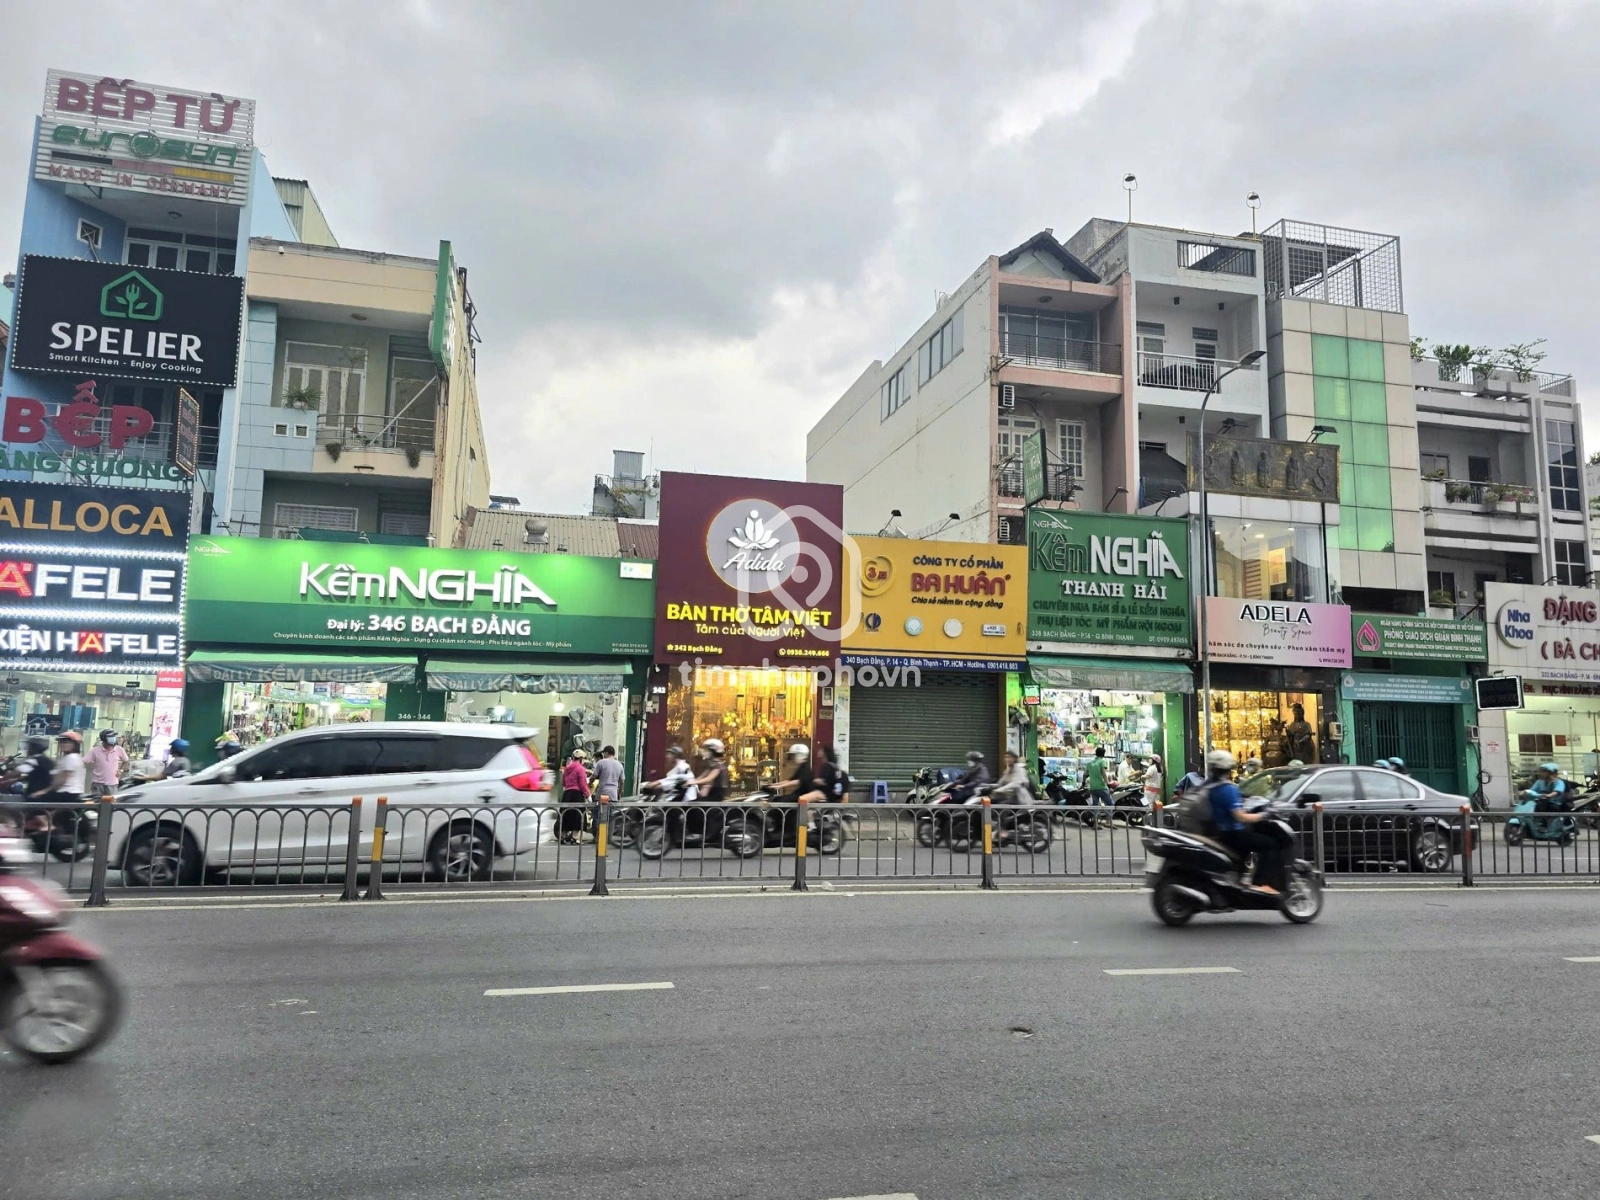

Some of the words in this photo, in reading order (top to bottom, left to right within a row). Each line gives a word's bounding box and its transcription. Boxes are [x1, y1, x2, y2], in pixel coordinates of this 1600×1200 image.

[56, 77, 156, 121] BẾP
[166, 92, 241, 134] TỪ
[49, 163, 102, 183] MADE
[116, 172, 134, 187] IN
[146, 177, 233, 200] GERMANY
[50, 322, 203, 362] SPELIER
[49, 353, 78, 363] Smart
[81, 355, 119, 366] Kitchen
[130, 360, 157, 371] Enjoy
[160, 363, 202, 374] Cooking
[722, 552, 786, 572] Adida
[913, 555, 942, 566] CÔNG
[944, 558, 958, 567] TY
[960, 555, 975, 568] CỔ
[976, 556, 1004, 569] PHẦN
[911, 572, 942, 593] BA
[944, 570, 1006, 596] HUÂN
[1062, 579, 1125, 598] THANH
[1133, 579, 1168, 600] HẢI
[911, 596, 928, 604] Chia
[985, 598, 1003, 609] đồng
[1544, 595, 1598, 626] ĐẶNG
[327, 619, 348, 632] Đại
[350, 619, 365, 632] lý:
[367, 615, 407, 631] 346
[411, 615, 467, 637] BẠCH
[471, 613, 531, 636] ĐẰNG
[667, 601, 707, 621] BÀN
[710, 603, 751, 623] THỜ
[752, 606, 790, 625] TÂM
[793, 608, 832, 629] VIỆT
[1239, 604, 1312, 625] ADELA
[1507, 609, 1531, 623] Nha
[0, 624, 51, 656] KIỆN
[56, 630, 177, 655] HÄFELE
[696, 623, 719, 635] Tâm
[722, 623, 745, 635] của
[748, 627, 780, 637] Người
[783, 627, 805, 639] Việt
[1504, 625, 1533, 640] Khoa
[846, 656, 855, 664] 340
[856, 656, 870, 665] Bạch
[397, 713, 412, 721] 346
